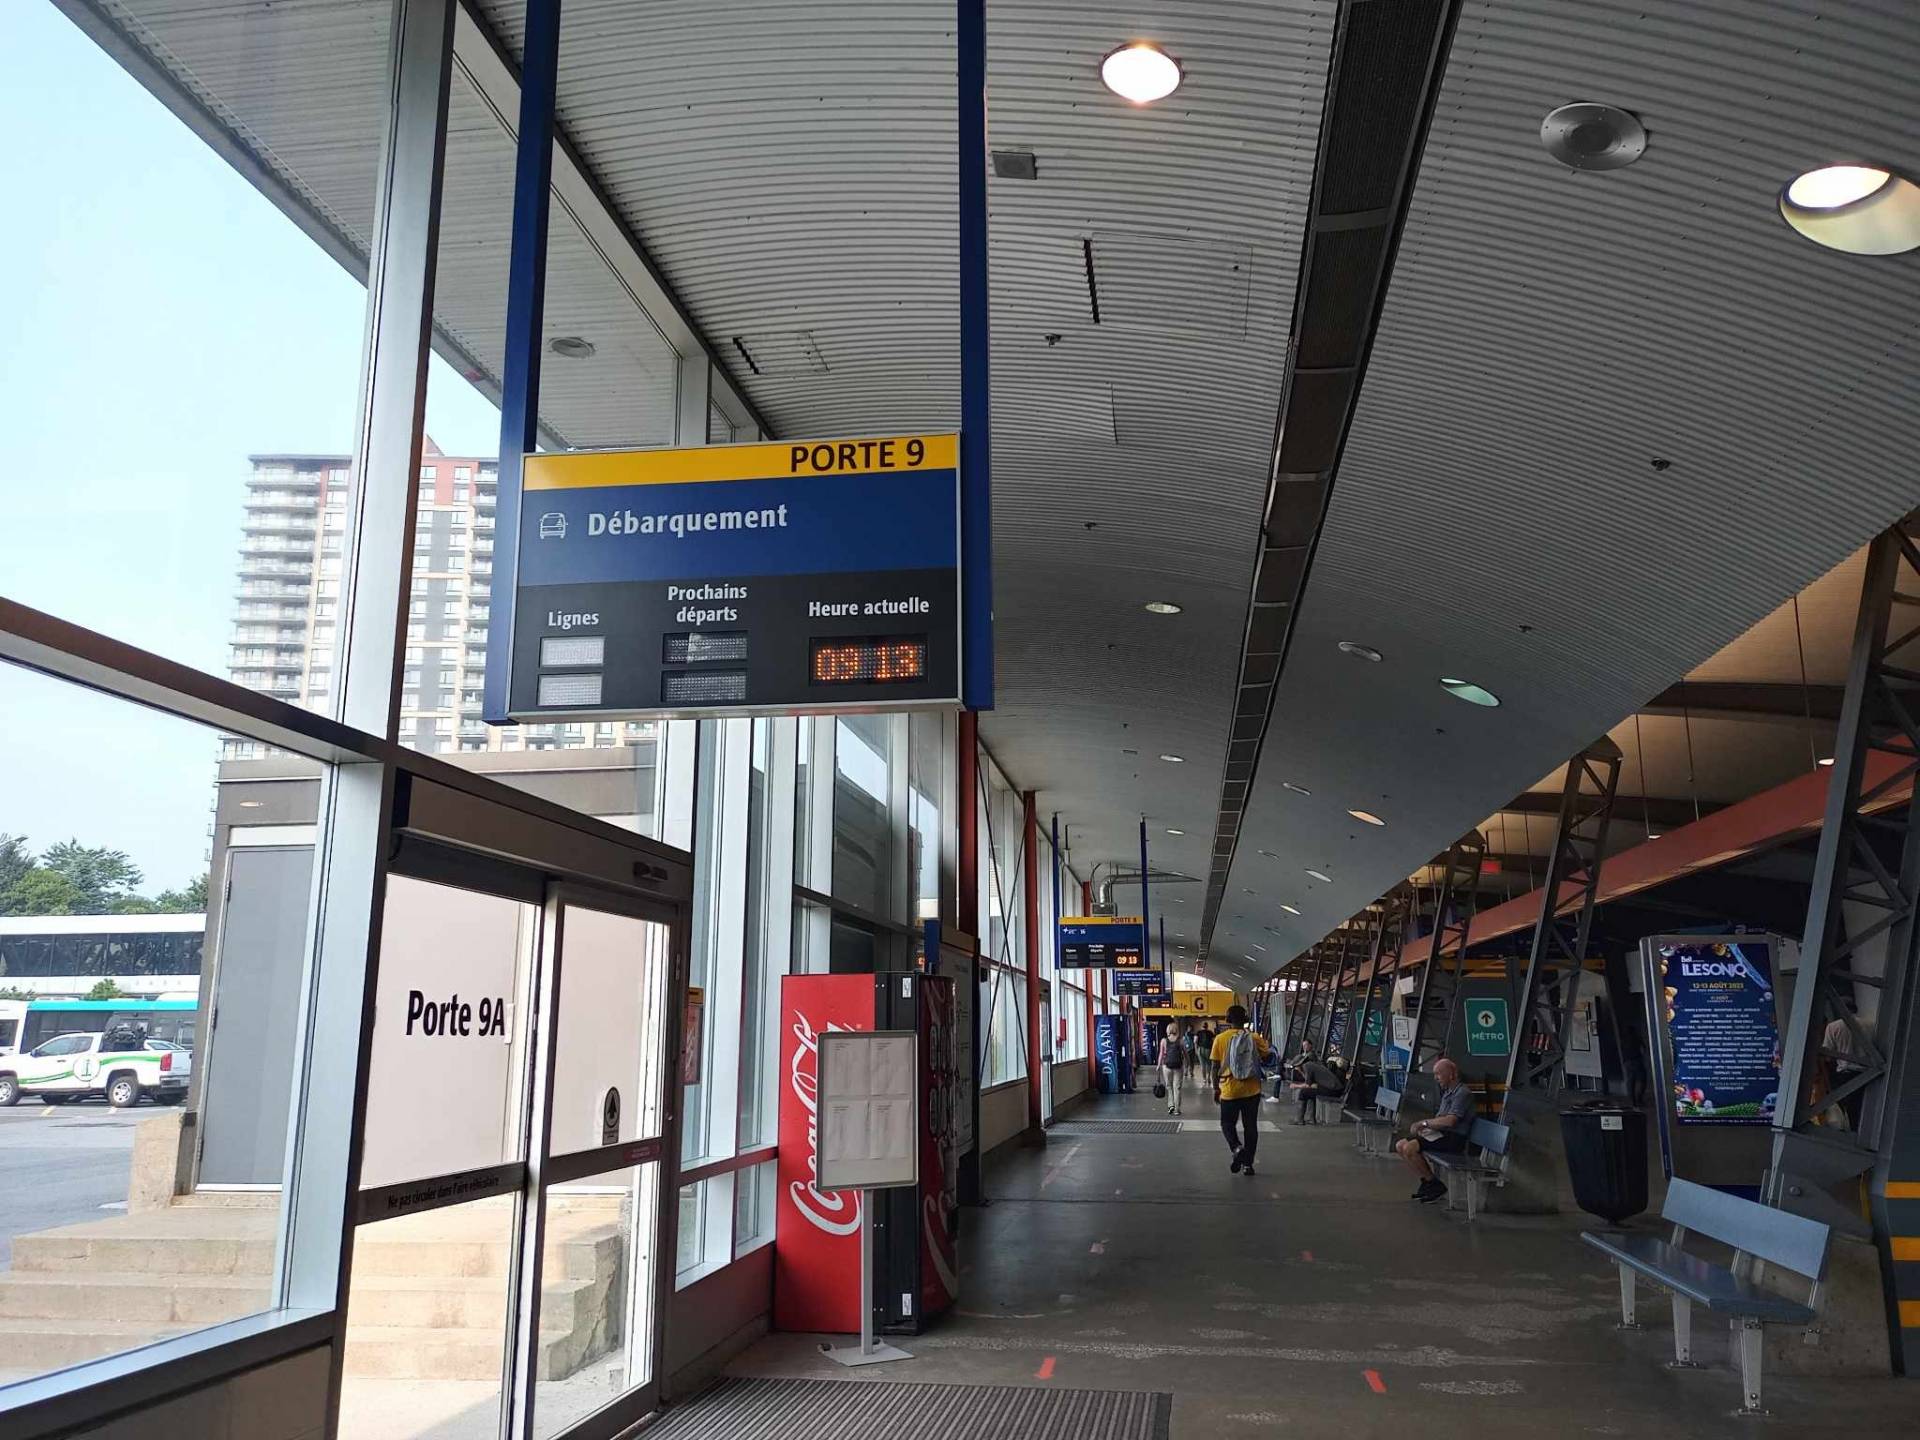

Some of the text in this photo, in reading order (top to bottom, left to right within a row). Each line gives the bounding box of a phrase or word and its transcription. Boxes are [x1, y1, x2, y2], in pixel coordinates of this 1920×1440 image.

[790, 439, 925, 473] PORTE 9
[588, 503, 788, 539] Débarquement
[667, 584, 748, 602] Prochains
[676, 606, 738, 624] départs
[808, 597, 930, 619] Heure actuelle
[547, 610, 600, 628] Lignes
[815, 645, 921, 681] 09 13
[1117, 956, 1138, 965] 09 13
[405, 989, 505, 1037] Porte 9A
[1194, 996, 1203, 1010] G
[1471, 1029, 1506, 1042] MÉTRO
[1099, 1024, 1113, 1074] DASANI
